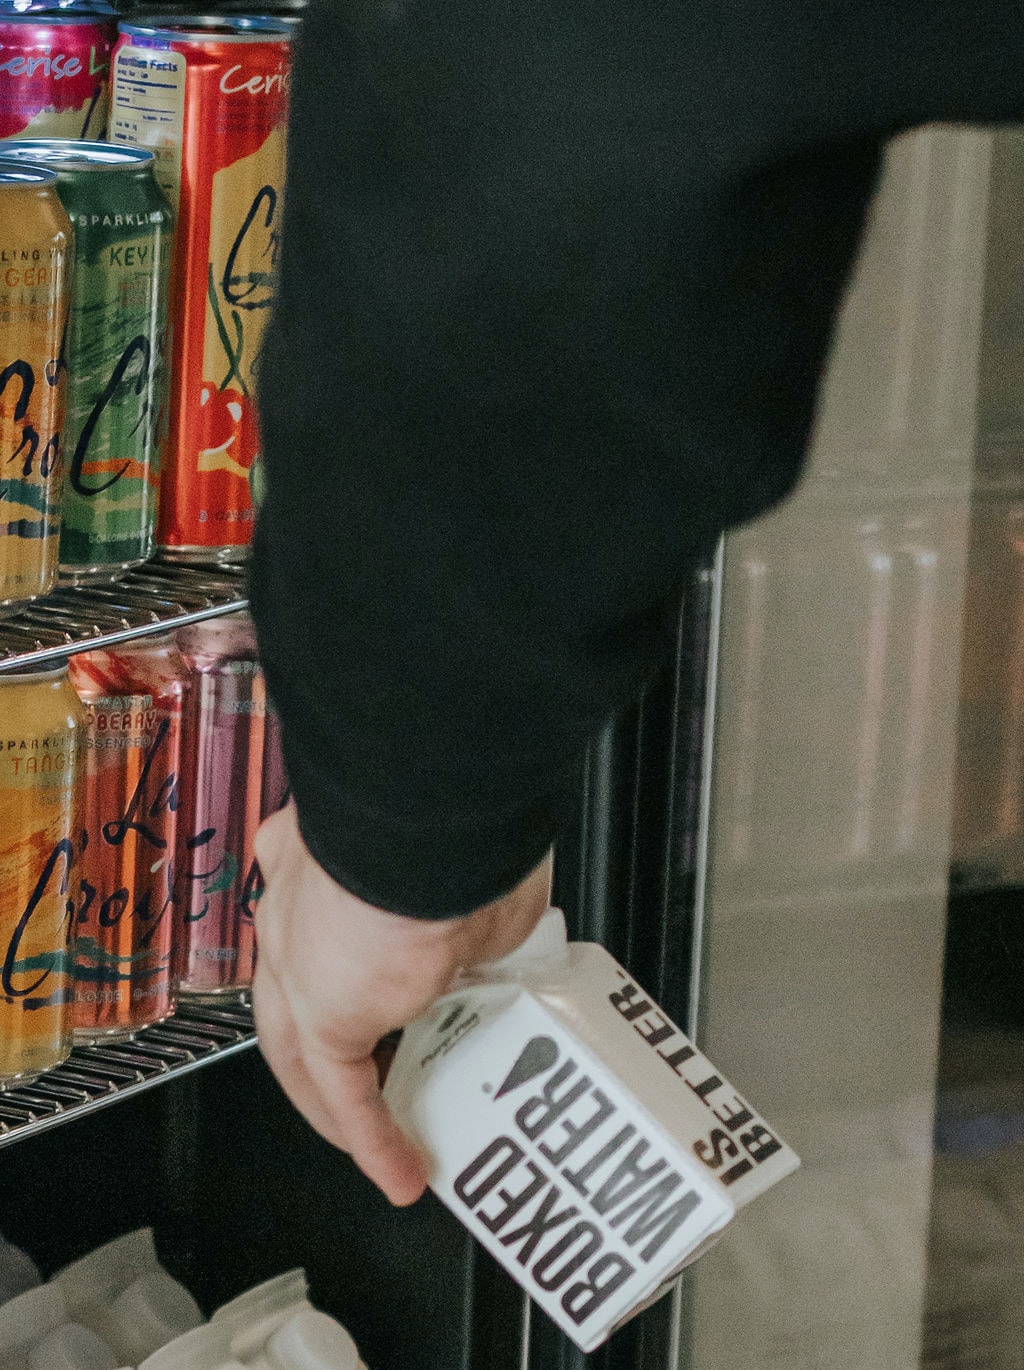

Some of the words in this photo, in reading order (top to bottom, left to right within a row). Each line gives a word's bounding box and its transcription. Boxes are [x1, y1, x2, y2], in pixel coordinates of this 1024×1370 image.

[110, 247, 148, 266] KEY
[513, 1057, 703, 1263] WATER
[608, 970, 783, 1163] BETTER.
[692, 1128, 752, 1185] IS
[453, 1134, 636, 1326] BOXED
